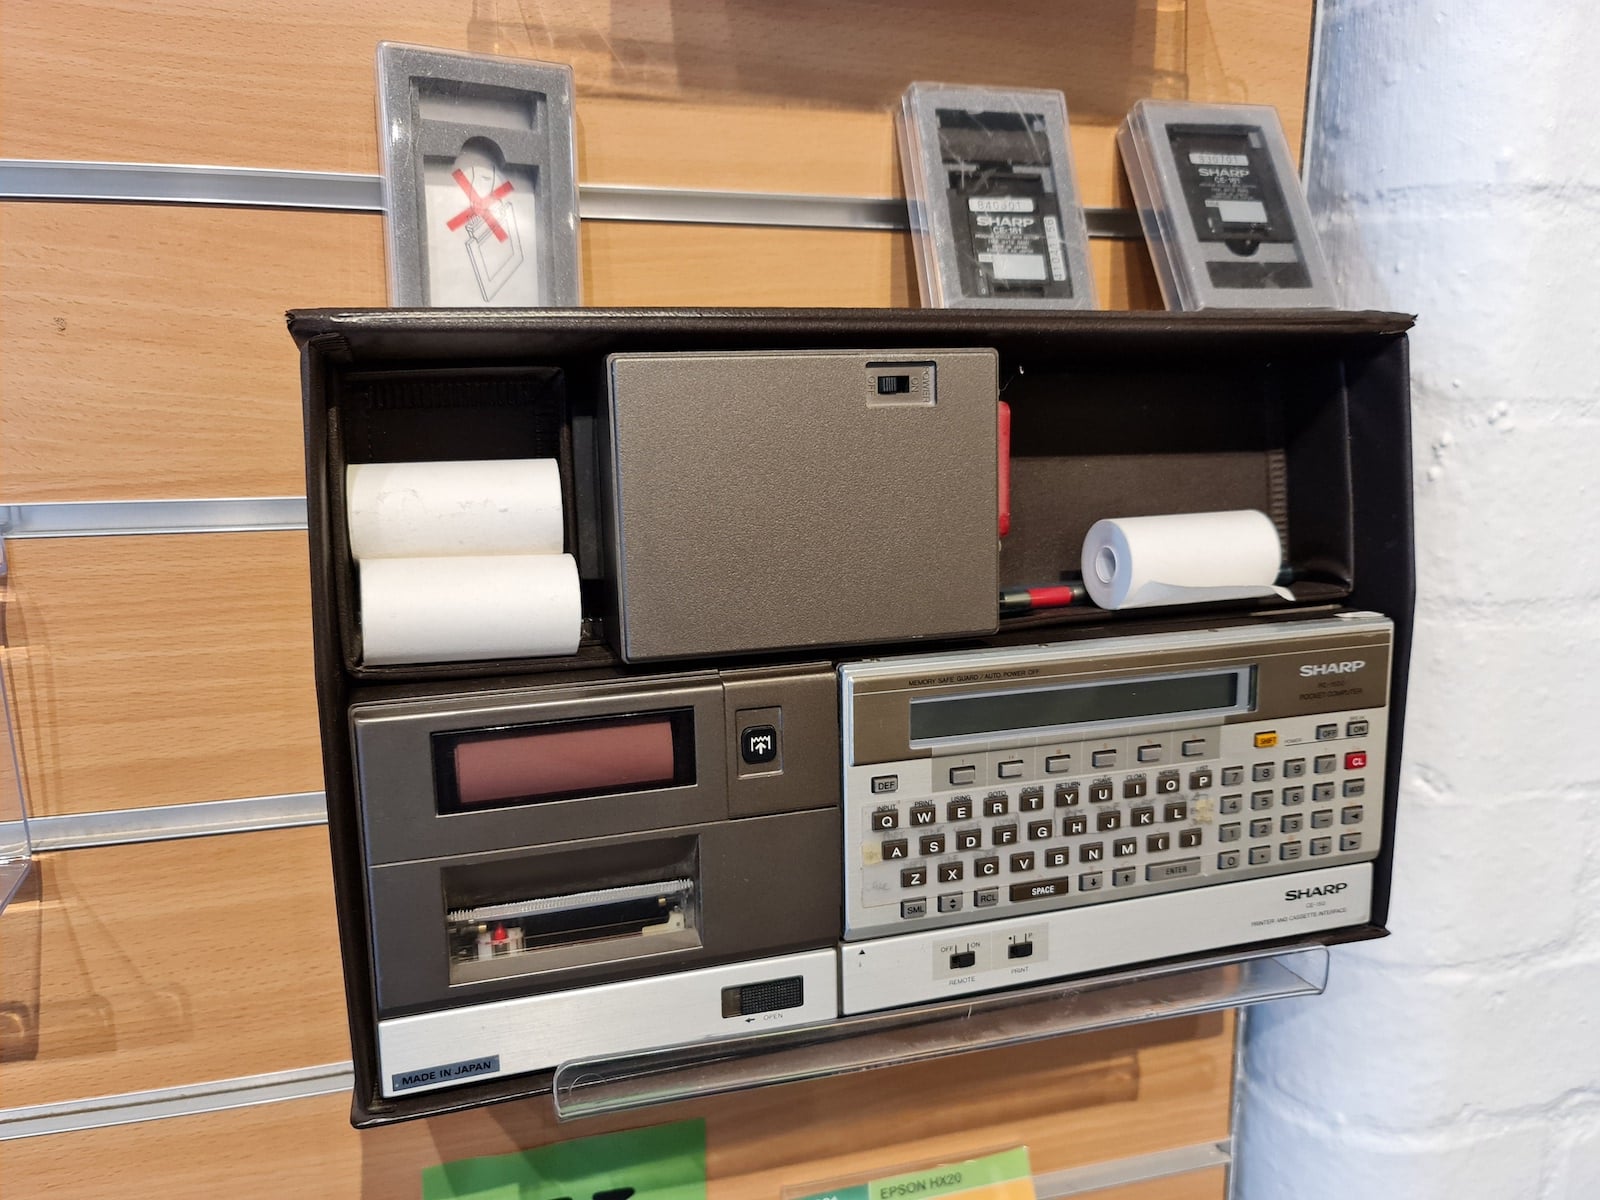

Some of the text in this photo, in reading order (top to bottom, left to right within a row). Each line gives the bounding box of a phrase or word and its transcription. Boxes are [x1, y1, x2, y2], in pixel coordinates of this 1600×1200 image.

[1198, 168, 1250, 177] SHARP
[976, 216, 1034, 227] SHARP
[911, 377, 919, 393] ON
[1300, 660, 1366, 677] SHARP
[909, 679, 936, 687] MEMORY
[939, 676, 955, 684] SAFE
[1003, 670, 1026, 678] POWER
[1327, 688, 1363, 697] COMPUTER
[1322, 729, 1338, 738] OFF
[1260, 736, 1277, 744] SHIFT
[1351, 757, 1365, 766] CL
[1262, 768, 1270, 778] 8
[1293, 764, 1302, 774] 9
[1093, 776, 1113, 784] CSAVE
[1126, 773, 1147, 781] CLOAD
[1199, 776, 1208, 786] P
[1231, 772, 1239, 782] 7
[878, 781, 895, 790] DEF
[1055, 781, 1081, 789] RETURN
[1166, 780, 1176, 790] O
[1348, 785, 1364, 793] MODE
[988, 790, 1007, 798] GOTO
[1064, 793, 1074, 804] Y
[1098, 789, 1108, 799] U
[1292, 793, 1300, 802] 6
[1029, 798, 1038, 808] T
[1229, 800, 1237, 810] 4
[1261, 797, 1269, 806] 5
[877, 803, 896, 811] INPUT
[993, 803, 1002, 813] R
[917, 811, 931, 823] W
[957, 807, 967, 818] E
[1173, 808, 1182, 818] L
[881, 816, 893, 827] Q
[1107, 818, 1114, 828] J
[1140, 813, 1150, 823] K
[1072, 822, 1082, 832] H
[1260, 824, 1267, 834] 2
[1291, 820, 1299, 830] 3
[1002, 832, 1011, 842] F
[1037, 827, 1048, 837] G
[930, 841, 939, 852] S
[966, 837, 976, 847] D
[891, 847, 902, 858] A
[1121, 843, 1133, 855] M
[1054, 854, 1064, 864] B
[1088, 849, 1099, 860] N
[1019, 859, 1029, 869] V
[1227, 856, 1235, 866] 0
[983, 863, 994, 874] C
[1165, 866, 1187, 875] ENTER
[911, 874, 920, 885] Z
[948, 869, 957, 880] X
[1031, 885, 1055, 896] SPACE
[1285, 882, 1348, 901] SHARP
[980, 893, 996, 903] RCL
[907, 906, 924, 915] SML
[1251, 918, 1275, 927] PRINTER
[1288, 911, 1317, 921] CASSETTE
[1318, 907, 1347, 916] INTERFACE
[1010, 966, 1029, 974] PRINT
[949, 976, 976, 986] REMOTE
[763, 1013, 784, 1021] OPEN
[402, 1061, 491, 1086] MADE IN JAPAN
[880, 1172, 962, 1199] EPSON HX20
